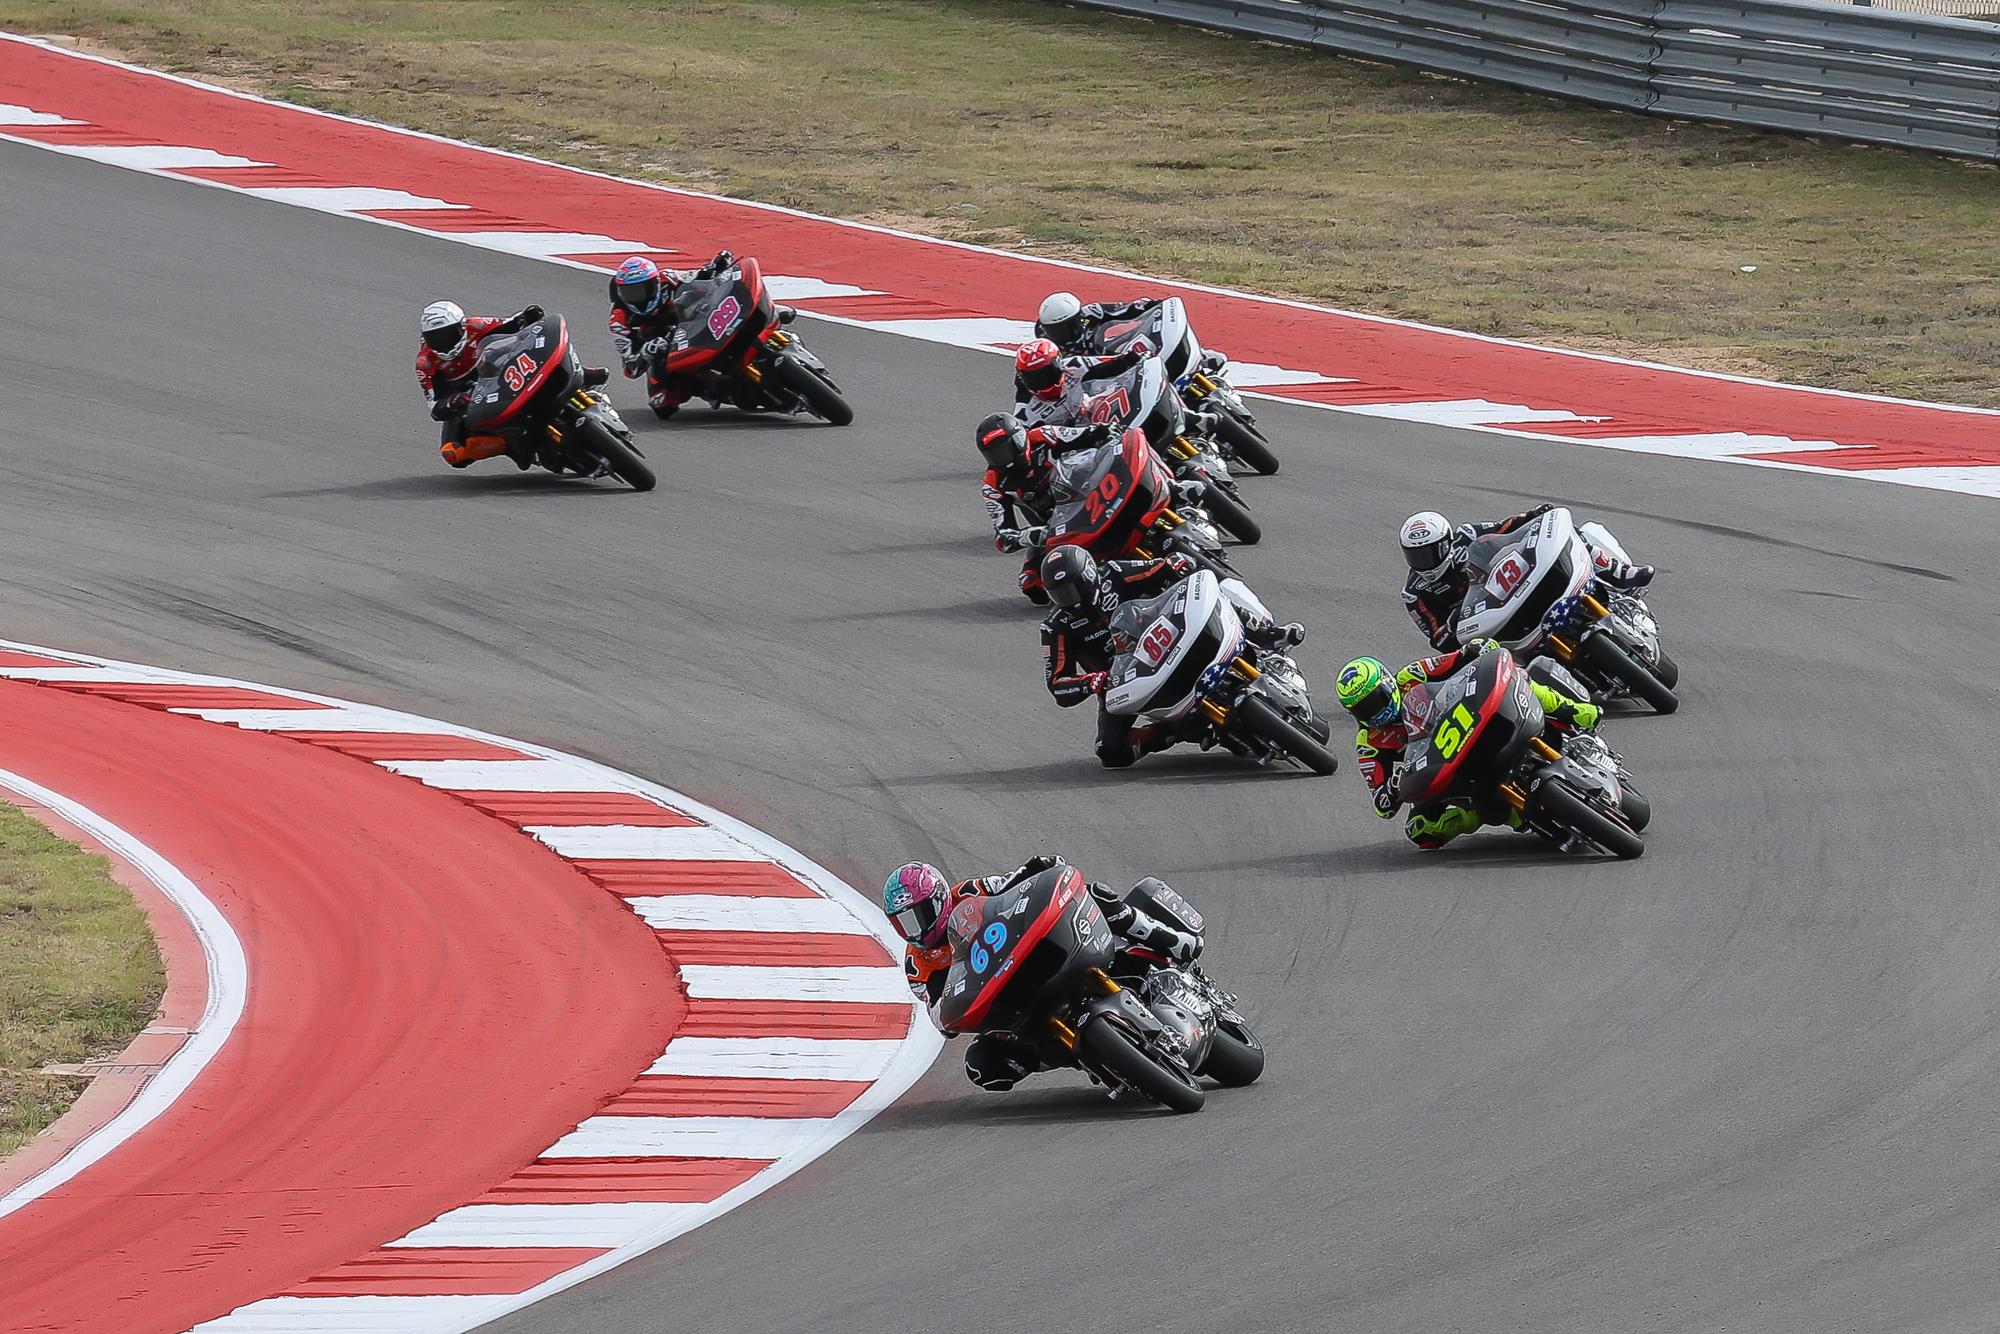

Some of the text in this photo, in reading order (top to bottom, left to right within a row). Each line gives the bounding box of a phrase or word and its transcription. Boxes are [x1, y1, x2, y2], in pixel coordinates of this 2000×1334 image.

[708, 296, 741, 340] 99
[504, 353, 538, 392] 34
[1086, 473, 1120, 525] 20
[1495, 559, 1522, 594] 13
[1143, 624, 1173, 661] 85
[1434, 703, 1475, 759] 51
[970, 921, 1008, 975] 69
